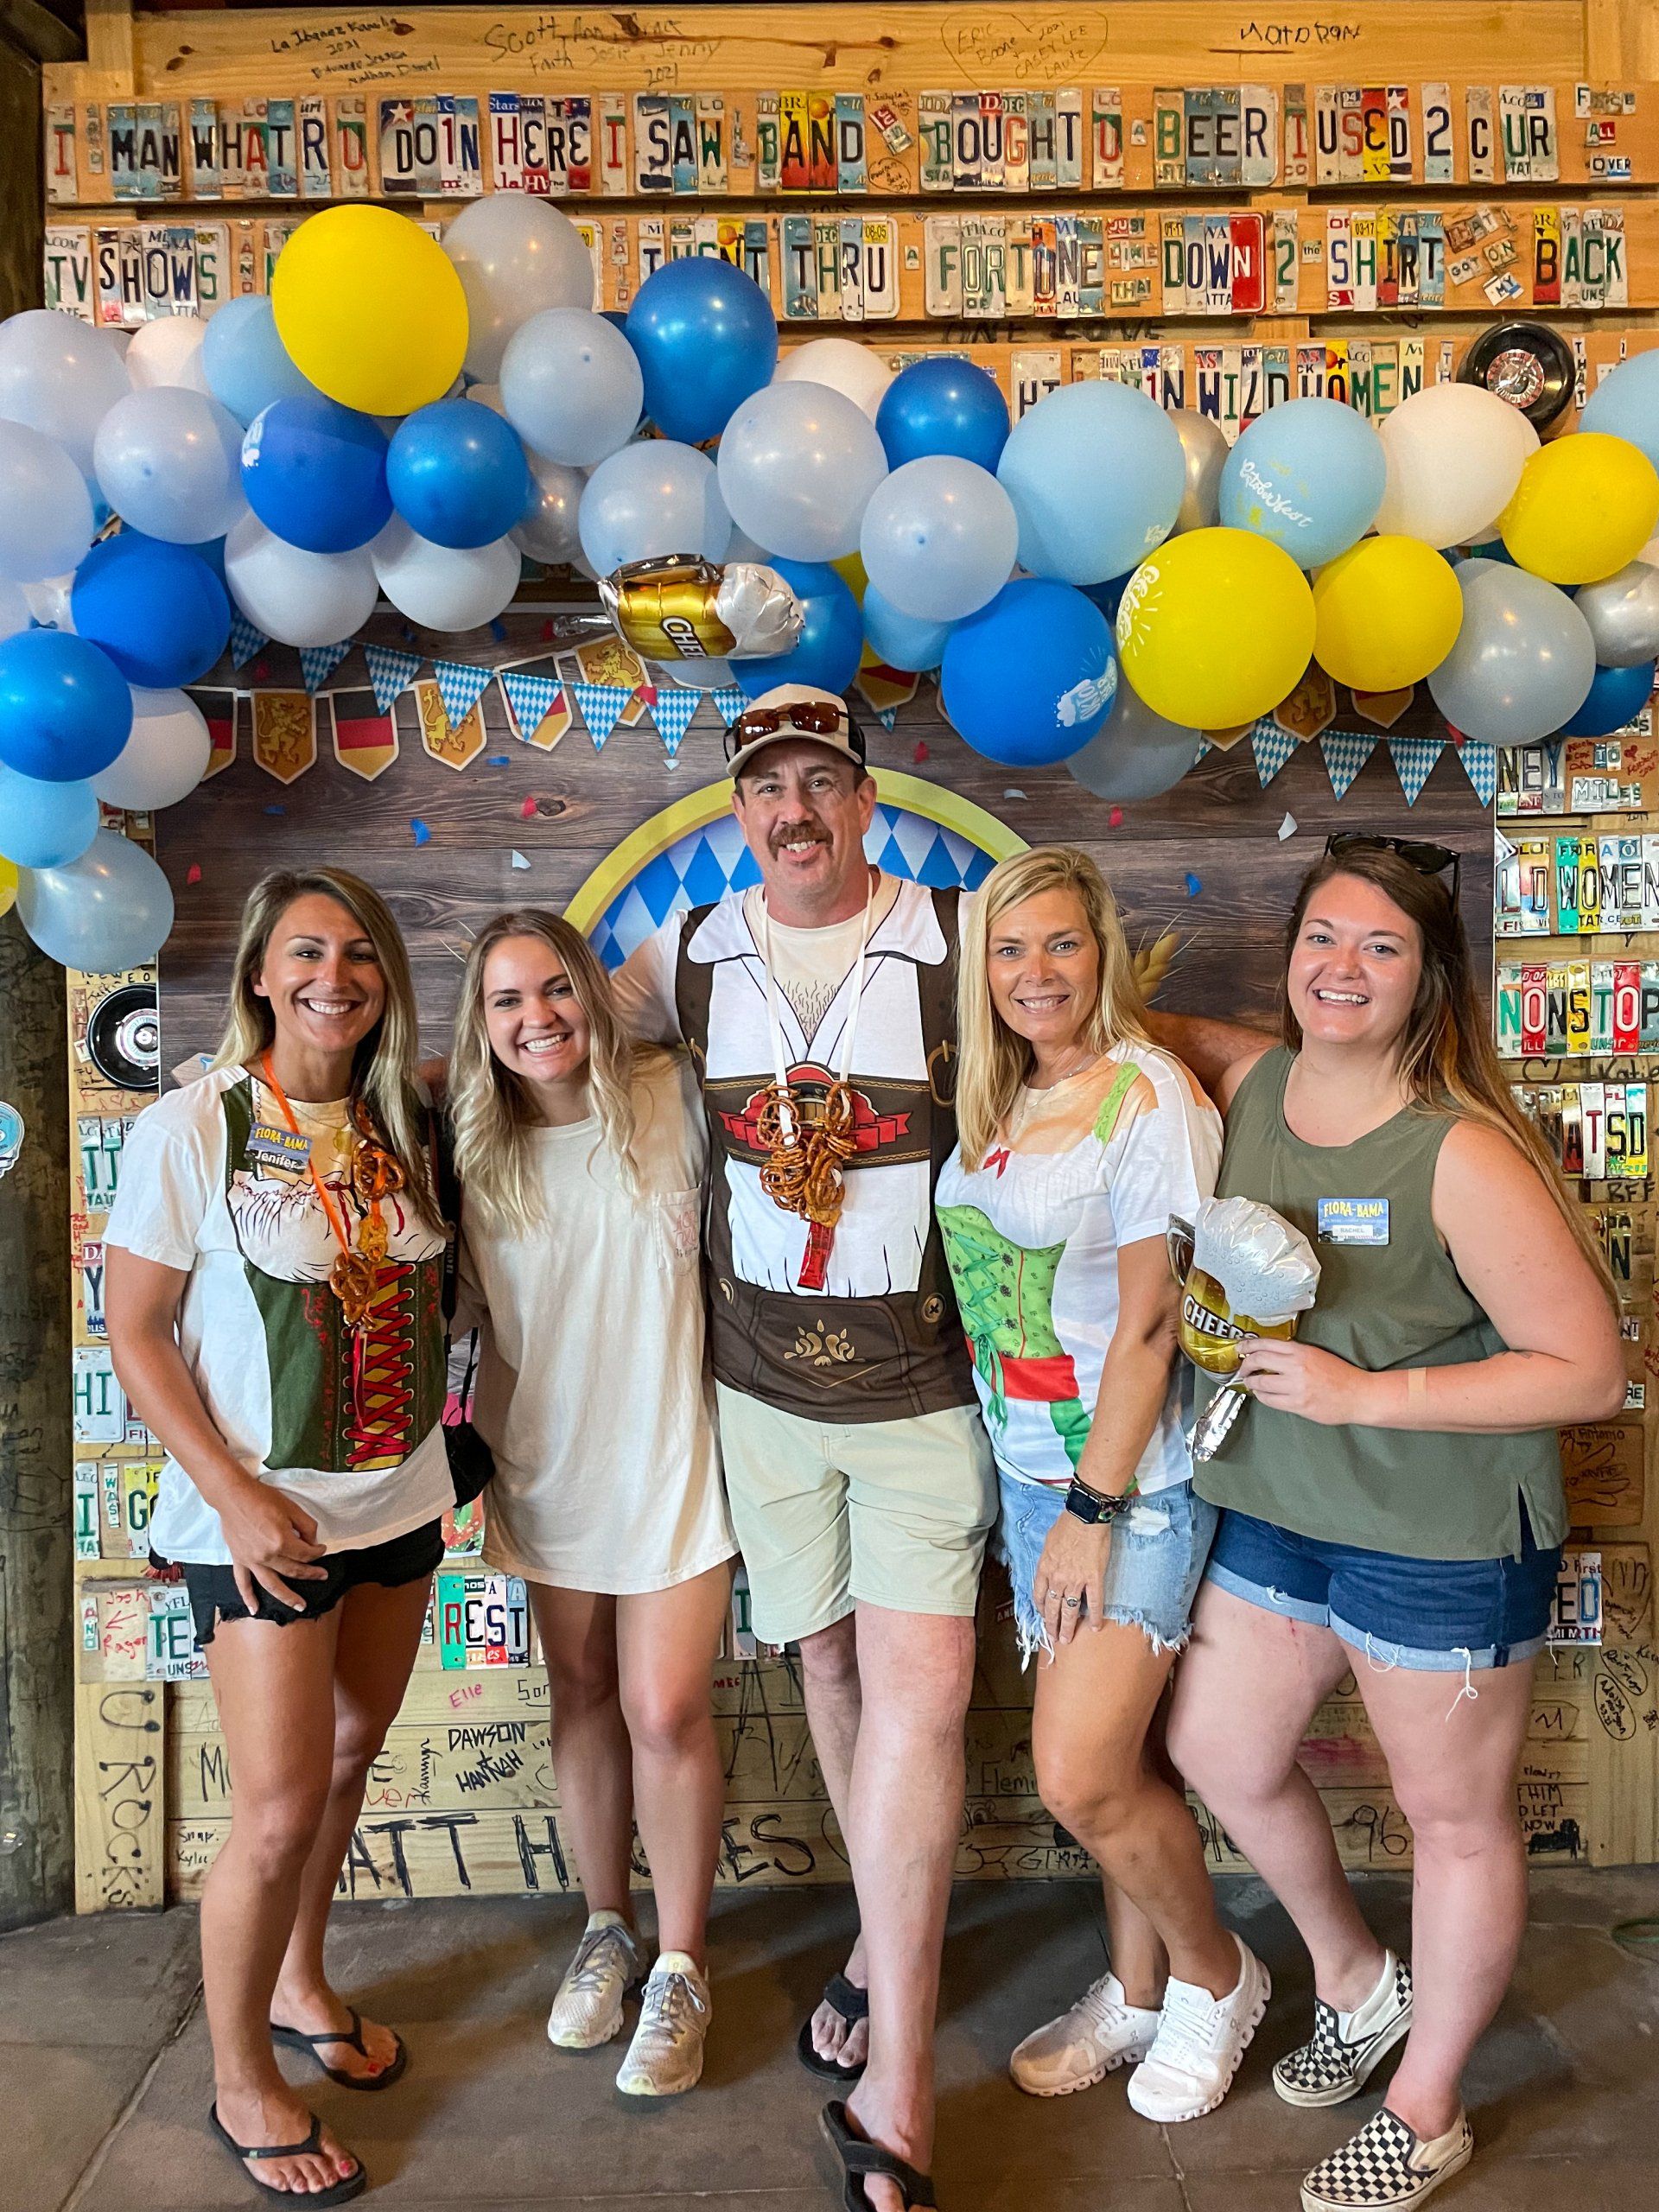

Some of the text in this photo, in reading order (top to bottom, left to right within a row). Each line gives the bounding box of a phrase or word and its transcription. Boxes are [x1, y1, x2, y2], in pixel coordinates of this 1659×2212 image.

[112, 127, 181, 176] MAN
[192, 124, 291, 172] WHAT
[649, 118, 721, 170] SAW
[759, 110, 864, 168] BAND
[935, 111, 1080, 165] BOUGHT
[1157, 107, 1268, 160] BEER
[1318, 108, 1408, 159] USED
[1427, 105, 1451, 157] 2
[1471, 117, 1488, 159] C
[1505, 113, 1551, 158] UR
[48, 256, 88, 302] TV
[99, 248, 217, 303] SHOWS
[791, 240, 886, 292] THRU
[1166, 239, 1250, 289] DOWN
[1277, 239, 1294, 286] 2
[1332, 237, 1443, 288] SHIRT
[1535, 234, 1623, 287] BACK
[1199, 372, 1290, 420] WILD
[1559, 862, 1659, 911] WOMEN
[1499, 986, 1659, 1035] NONSTOP
[254, 1128, 308, 1151] FLORA-BAMA
[254, 1149, 297, 1169] Jenifer
[1324, 1200, 1384, 1218] FLORA-BAMA
[444, 1599, 525, 1648] REST
[447, 1721, 527, 1752] DAWSON
[339, 1812, 480, 1900] ATT
